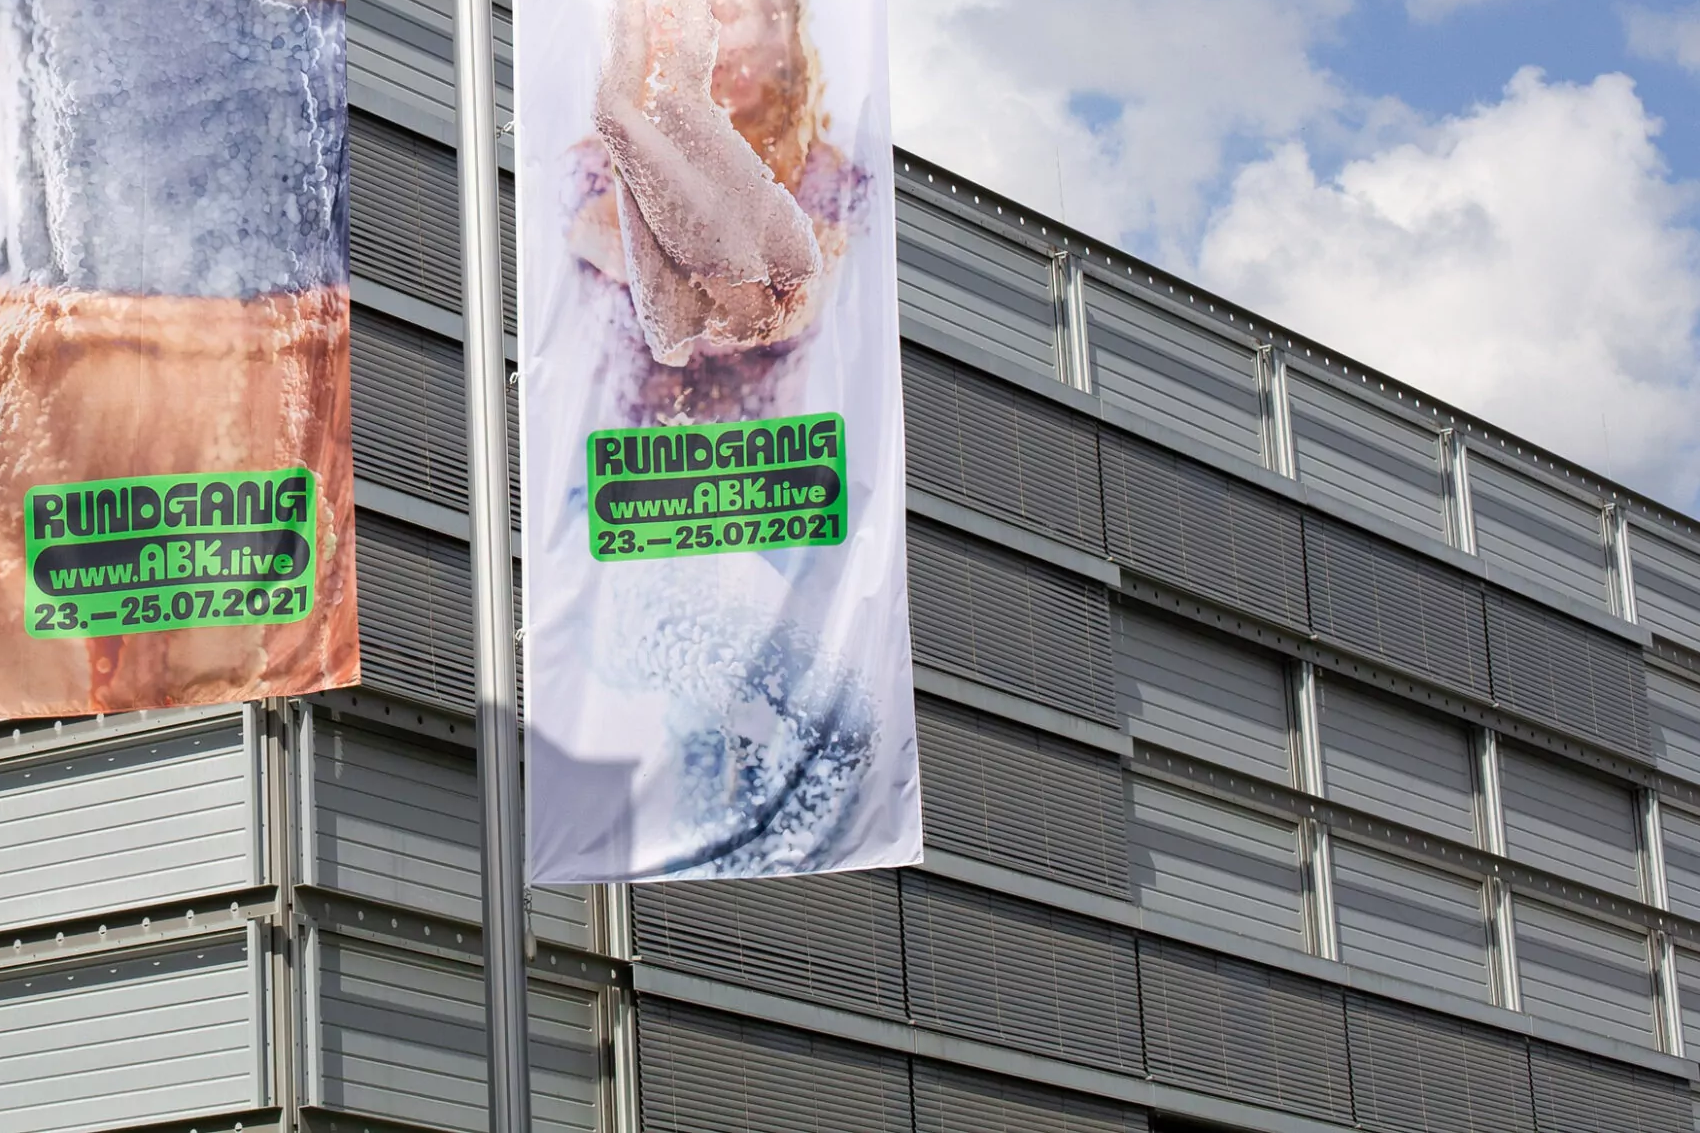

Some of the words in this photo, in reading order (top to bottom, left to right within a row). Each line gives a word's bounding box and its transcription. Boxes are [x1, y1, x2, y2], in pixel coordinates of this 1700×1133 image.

[594, 419, 838, 477] RUNDGANG
[32, 476, 307, 540] RUNDGANG
[609, 476, 827, 519] www.ABK.live
[49, 538, 294, 590] www.ABK.live
